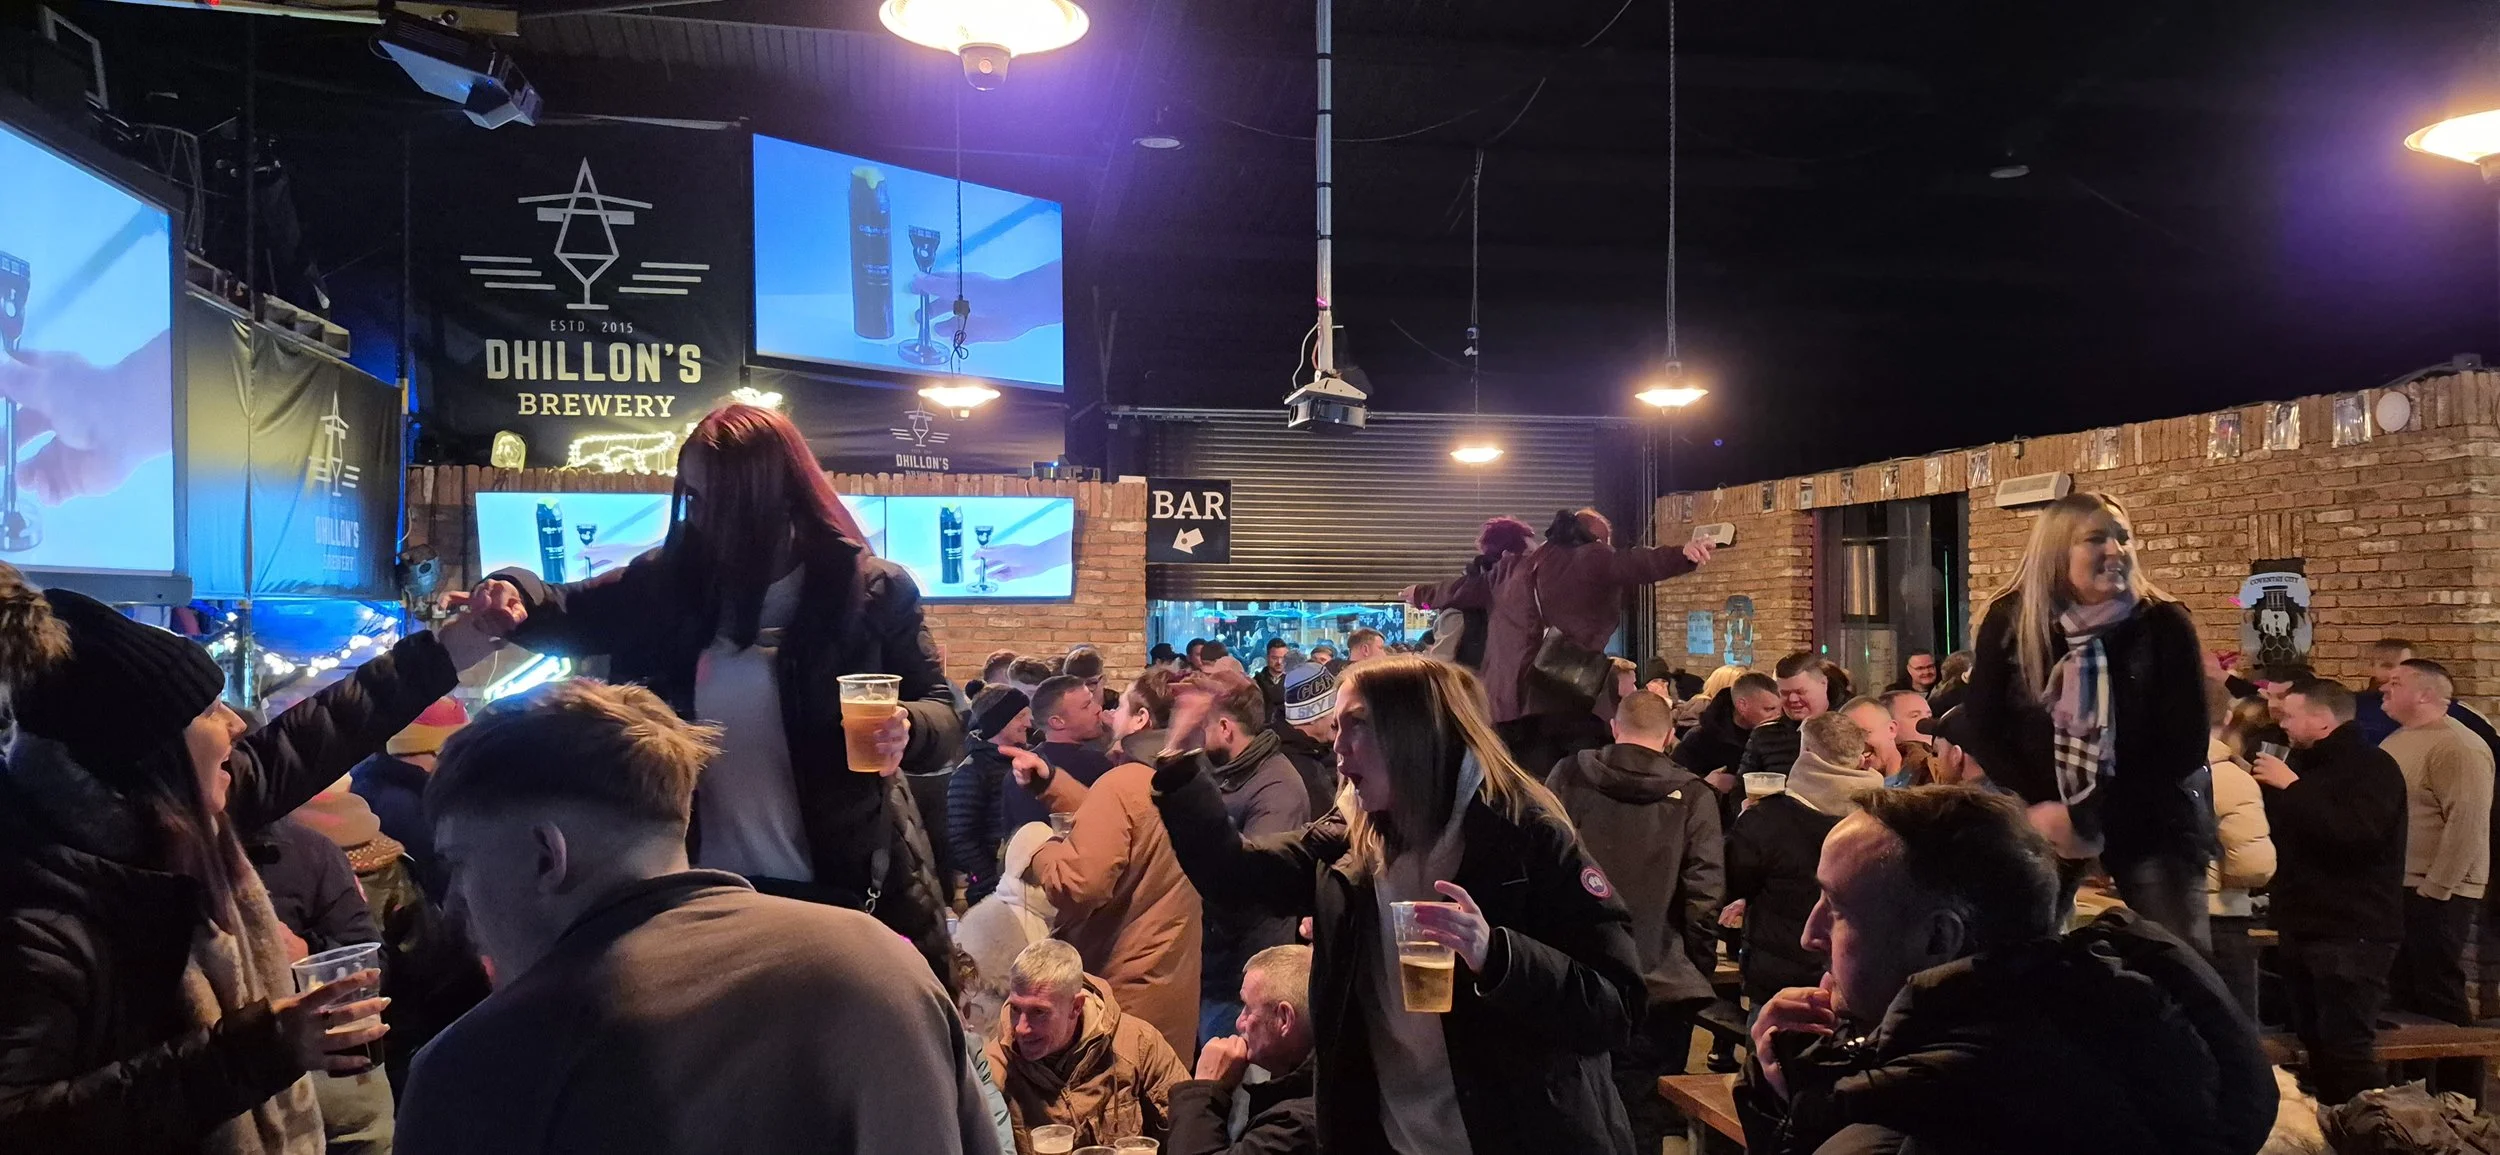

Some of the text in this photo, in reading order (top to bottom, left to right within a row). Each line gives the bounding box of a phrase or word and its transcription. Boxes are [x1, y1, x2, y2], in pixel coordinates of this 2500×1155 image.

[601, 322, 633, 333] 2015
[485, 339, 702, 383] DHILLON'S
[517, 392, 676, 417] BREWERY
[895, 454, 949, 470] DHILLON'S
[1152, 490, 1227, 520] BAR
[2249, 575, 2300, 586] COVENTRY CITY
[1298, 700, 1325, 718] SKY
